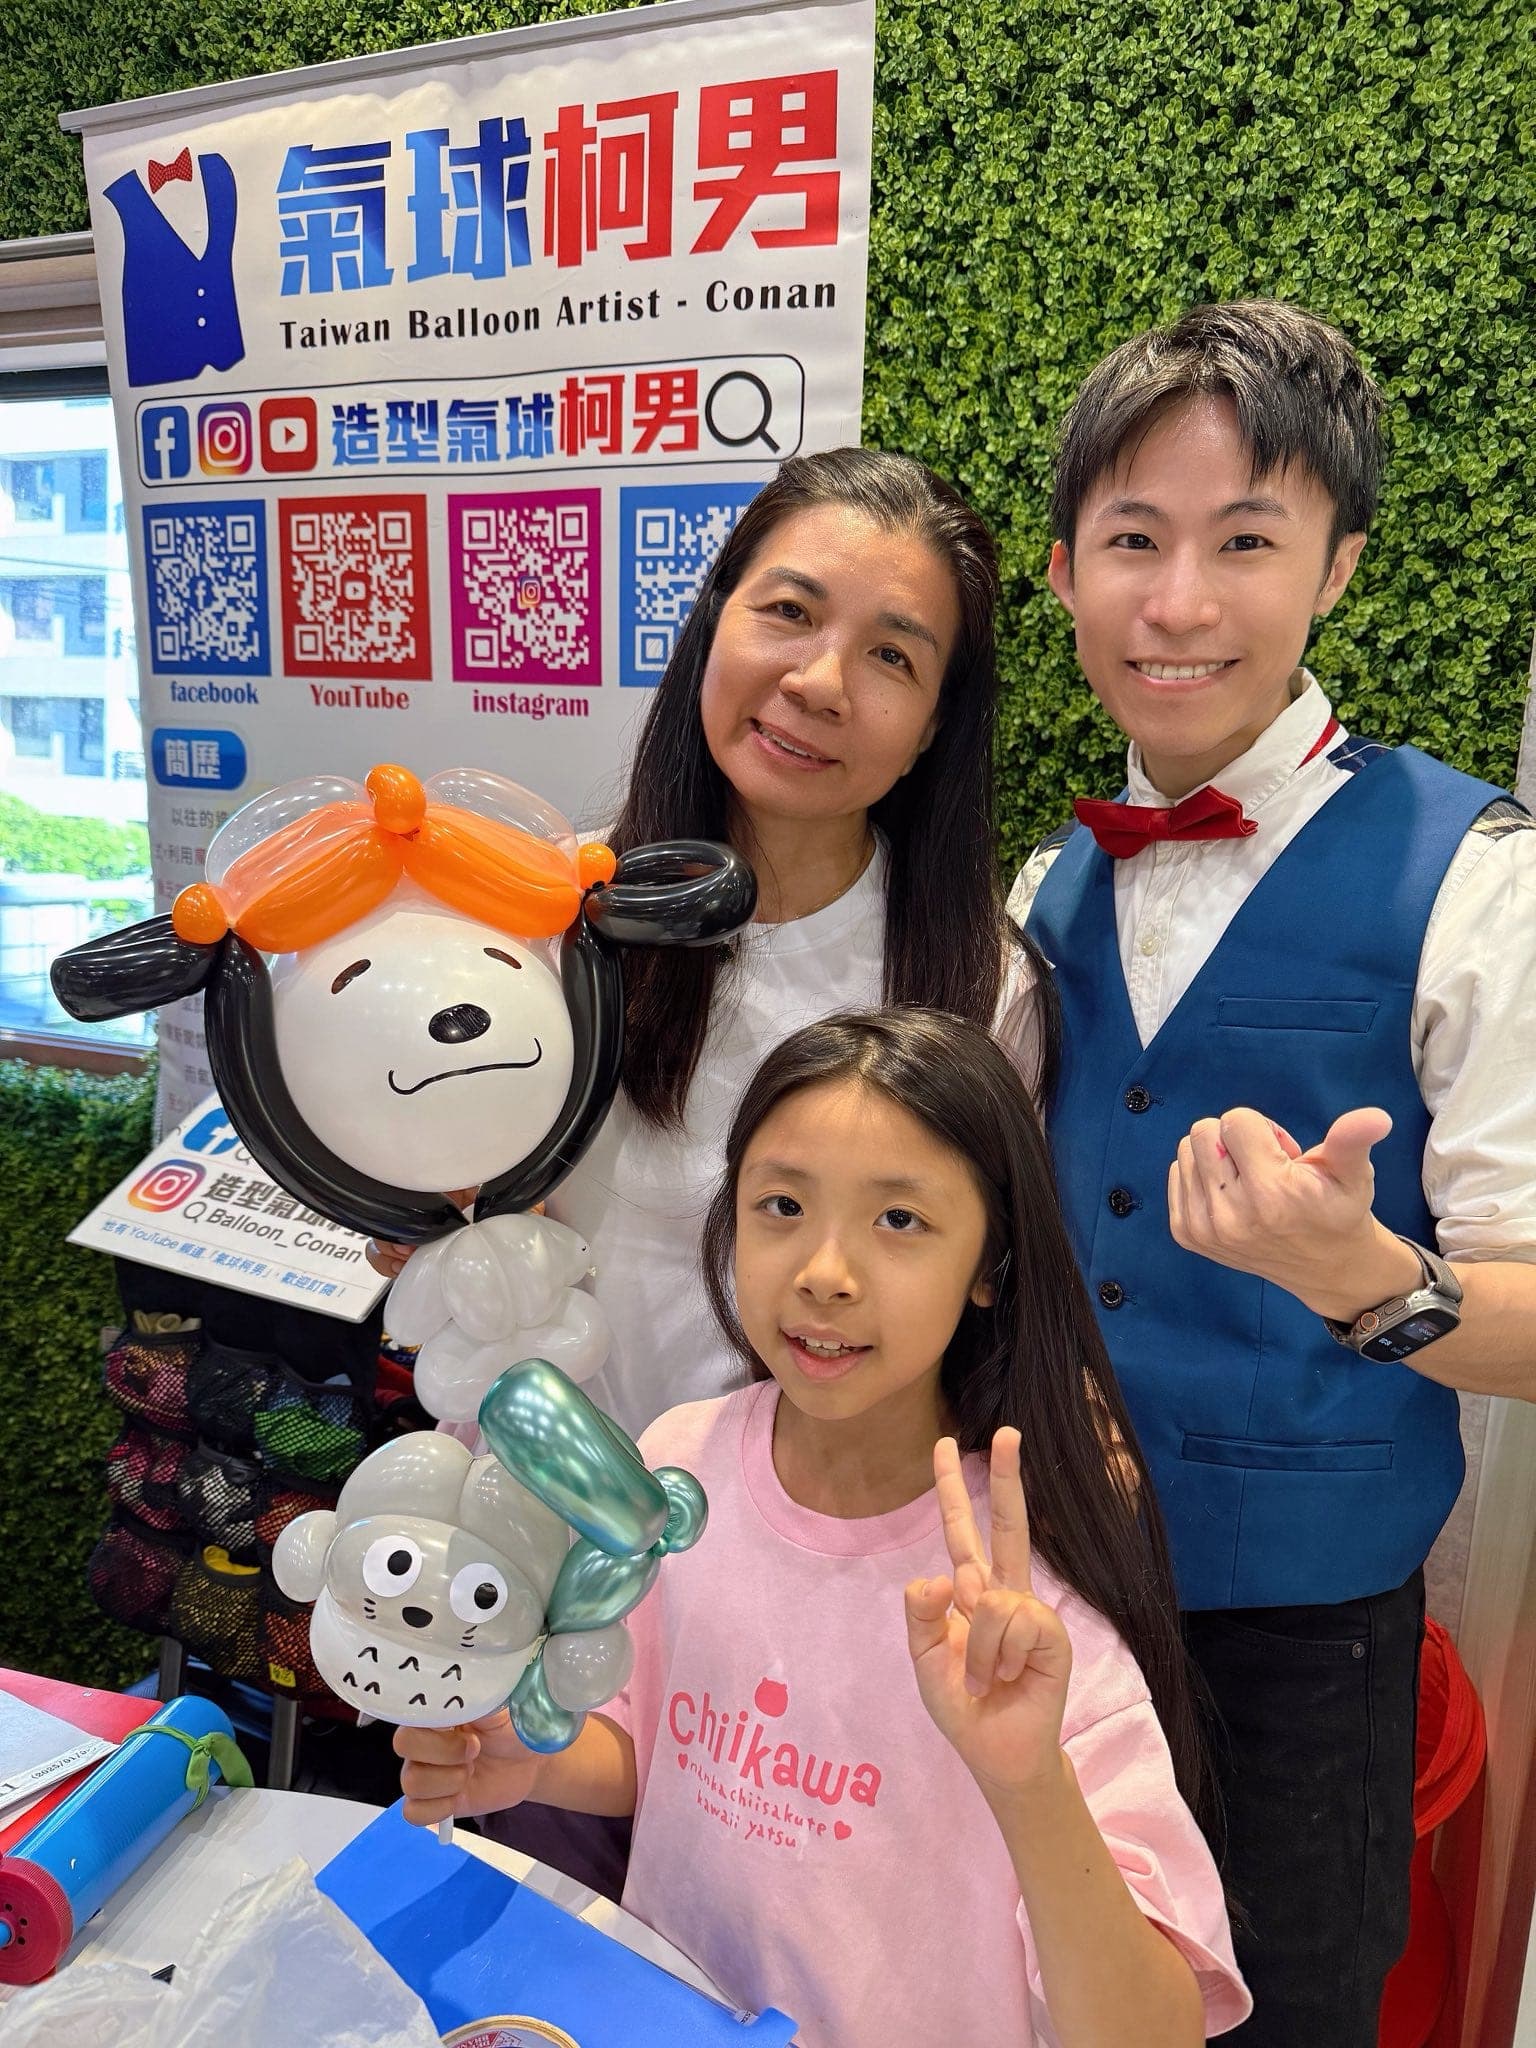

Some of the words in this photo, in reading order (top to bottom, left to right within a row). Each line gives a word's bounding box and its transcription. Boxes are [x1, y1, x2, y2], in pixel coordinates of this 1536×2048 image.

[276, 69, 840, 297] 氣球柯男
[279, 315, 391, 350] Taiwan
[408, 307, 540, 340] Balloon
[556, 291, 661, 327] Artist
[706, 280, 838, 313] Conan
[331, 369, 700, 467] 造型氣球柯男
[170, 681, 259, 706] facebook
[310, 684, 410, 711] YouTube
[473, 689, 590, 720] instagram
[130, 1226, 179, 1249] YouTube
[206, 1207, 362, 1263] Balloon_Conan
[668, 1691, 882, 1808] Chiikawa
[697, 1790, 740, 1829] kawaii
[744, 1820, 796, 1848] yatsu
